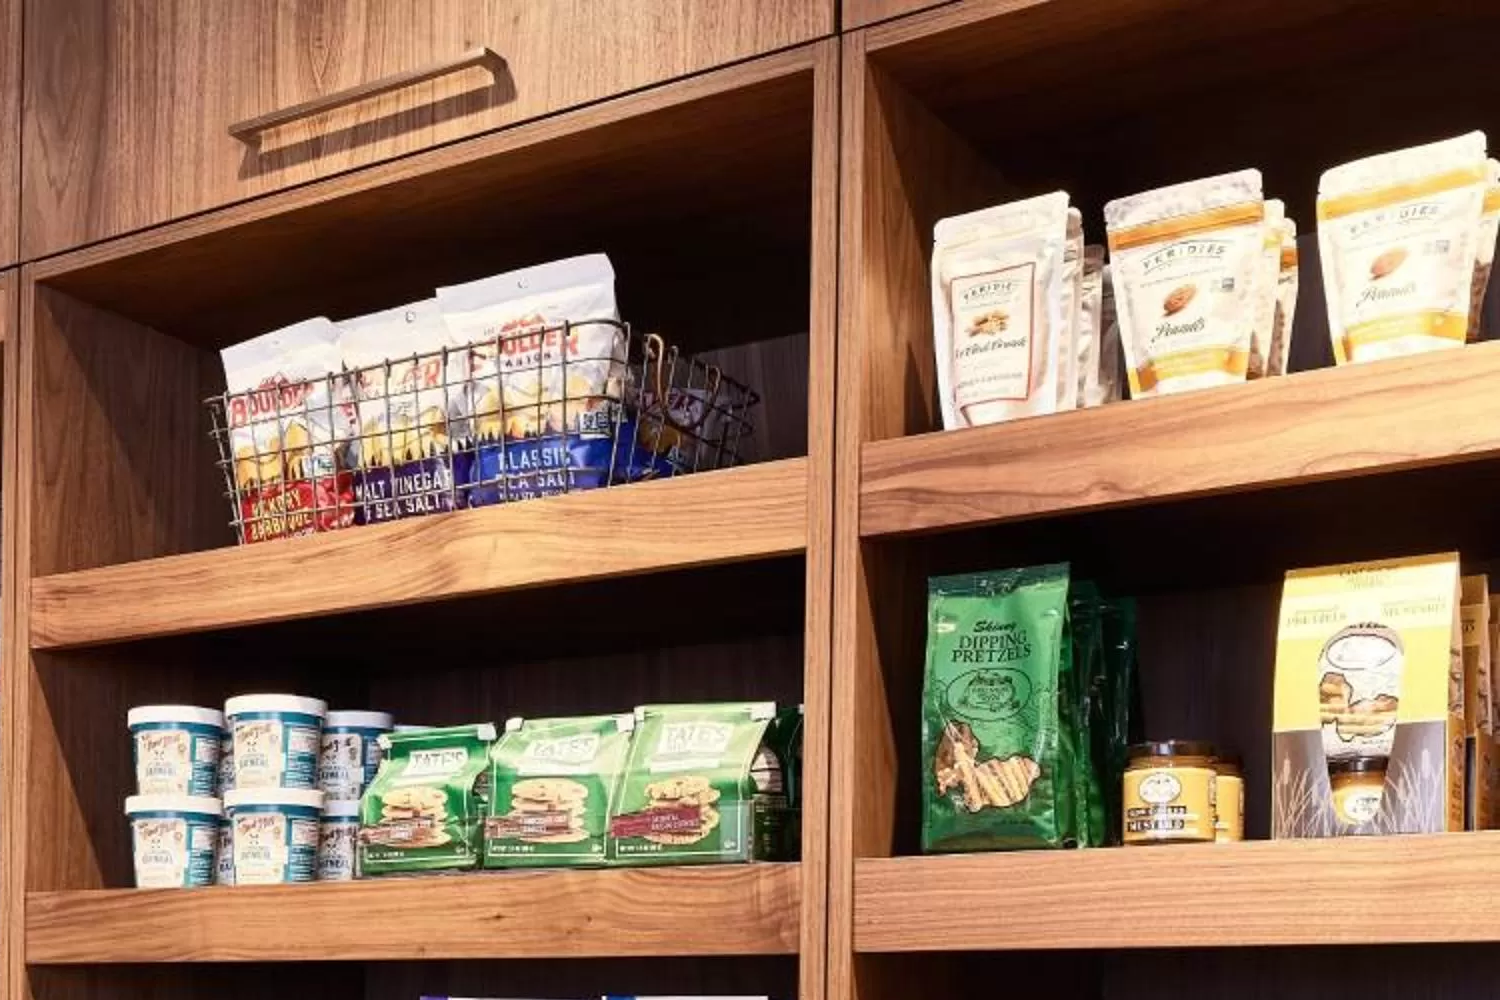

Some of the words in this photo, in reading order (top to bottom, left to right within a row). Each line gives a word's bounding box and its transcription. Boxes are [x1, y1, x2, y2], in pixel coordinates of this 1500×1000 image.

[407, 493, 442, 514] SALT
[958, 628, 1028, 650] DIPPING
[951, 642, 1032, 663] PRETZELS
